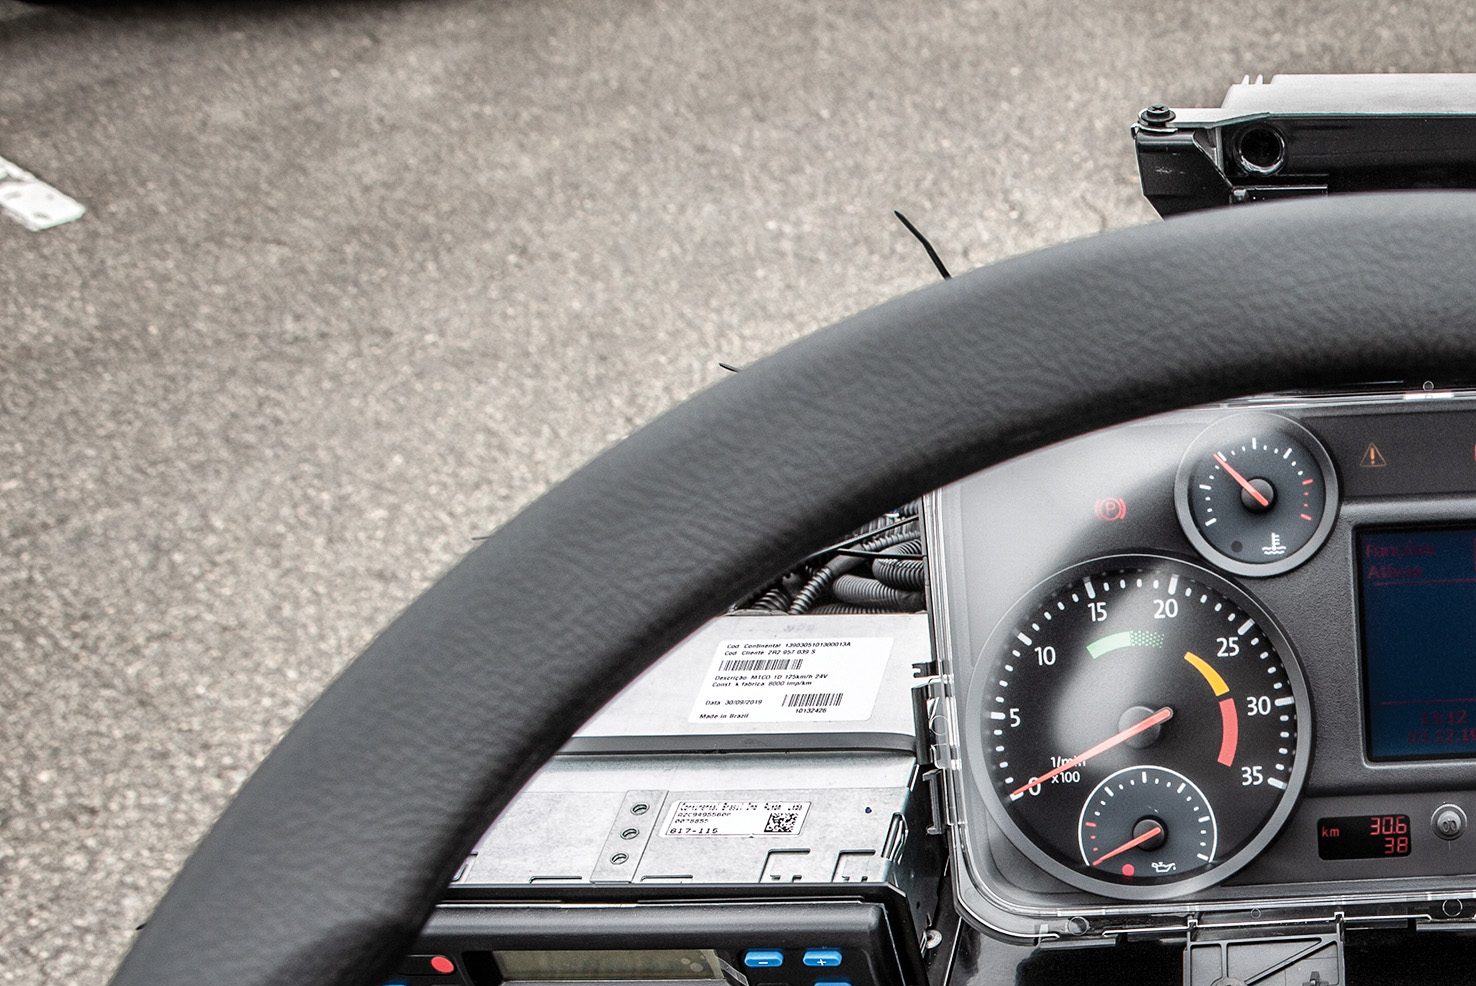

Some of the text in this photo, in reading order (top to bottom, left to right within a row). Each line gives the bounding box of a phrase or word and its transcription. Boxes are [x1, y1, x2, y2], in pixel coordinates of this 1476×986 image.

[1087, 602, 1108, 622] 15
[1154, 598, 1179, 619] 20
[1035, 646, 1056, 666] 10
[1217, 637, 1240, 657] 25
[1247, 696, 1271, 716] 30
[1009, 708, 1021, 727] 5
[1051, 771, 1080, 785] x100
[1241, 766, 1263, 786] 35
[1028, 777, 1041, 796] 0
[1322, 827, 1340, 838] km
[1384, 837, 1409, 854] 38
